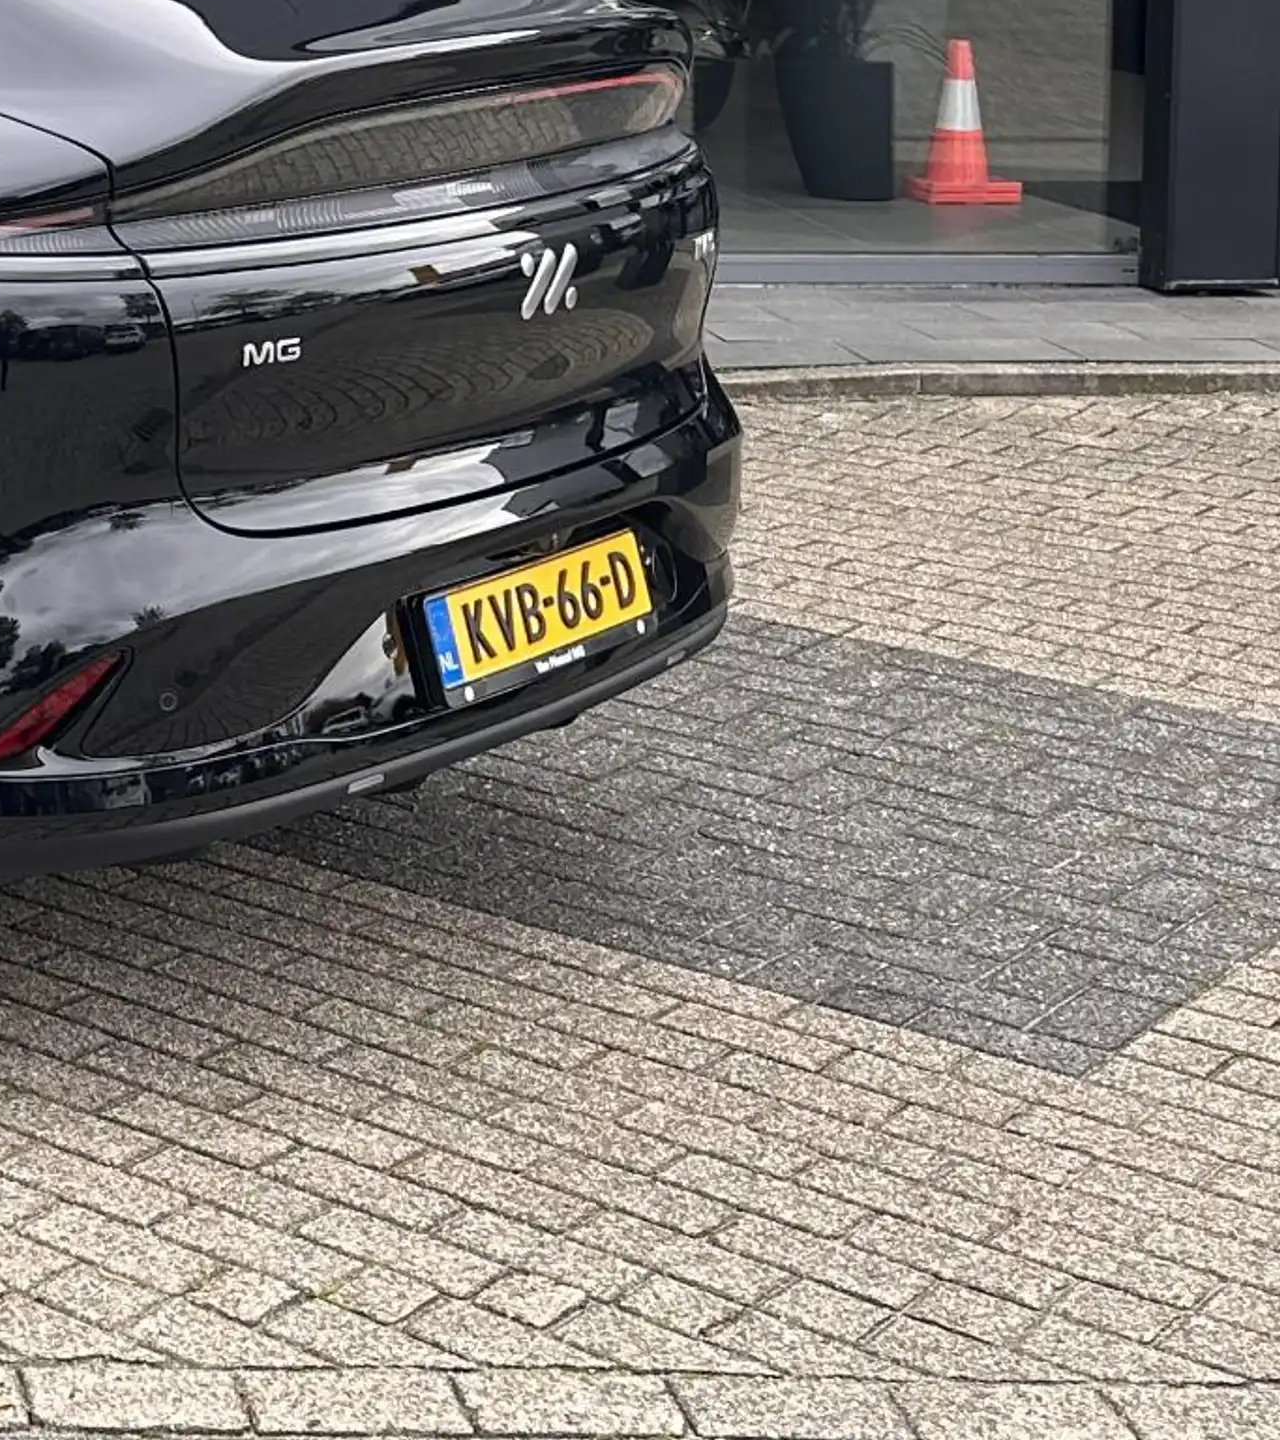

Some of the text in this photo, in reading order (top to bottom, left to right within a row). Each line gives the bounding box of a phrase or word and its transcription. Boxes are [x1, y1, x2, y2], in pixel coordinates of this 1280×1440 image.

[243, 337, 301, 367] MG
[460, 550, 637, 665] KVB-66-D
[438, 650, 460, 673] NL
